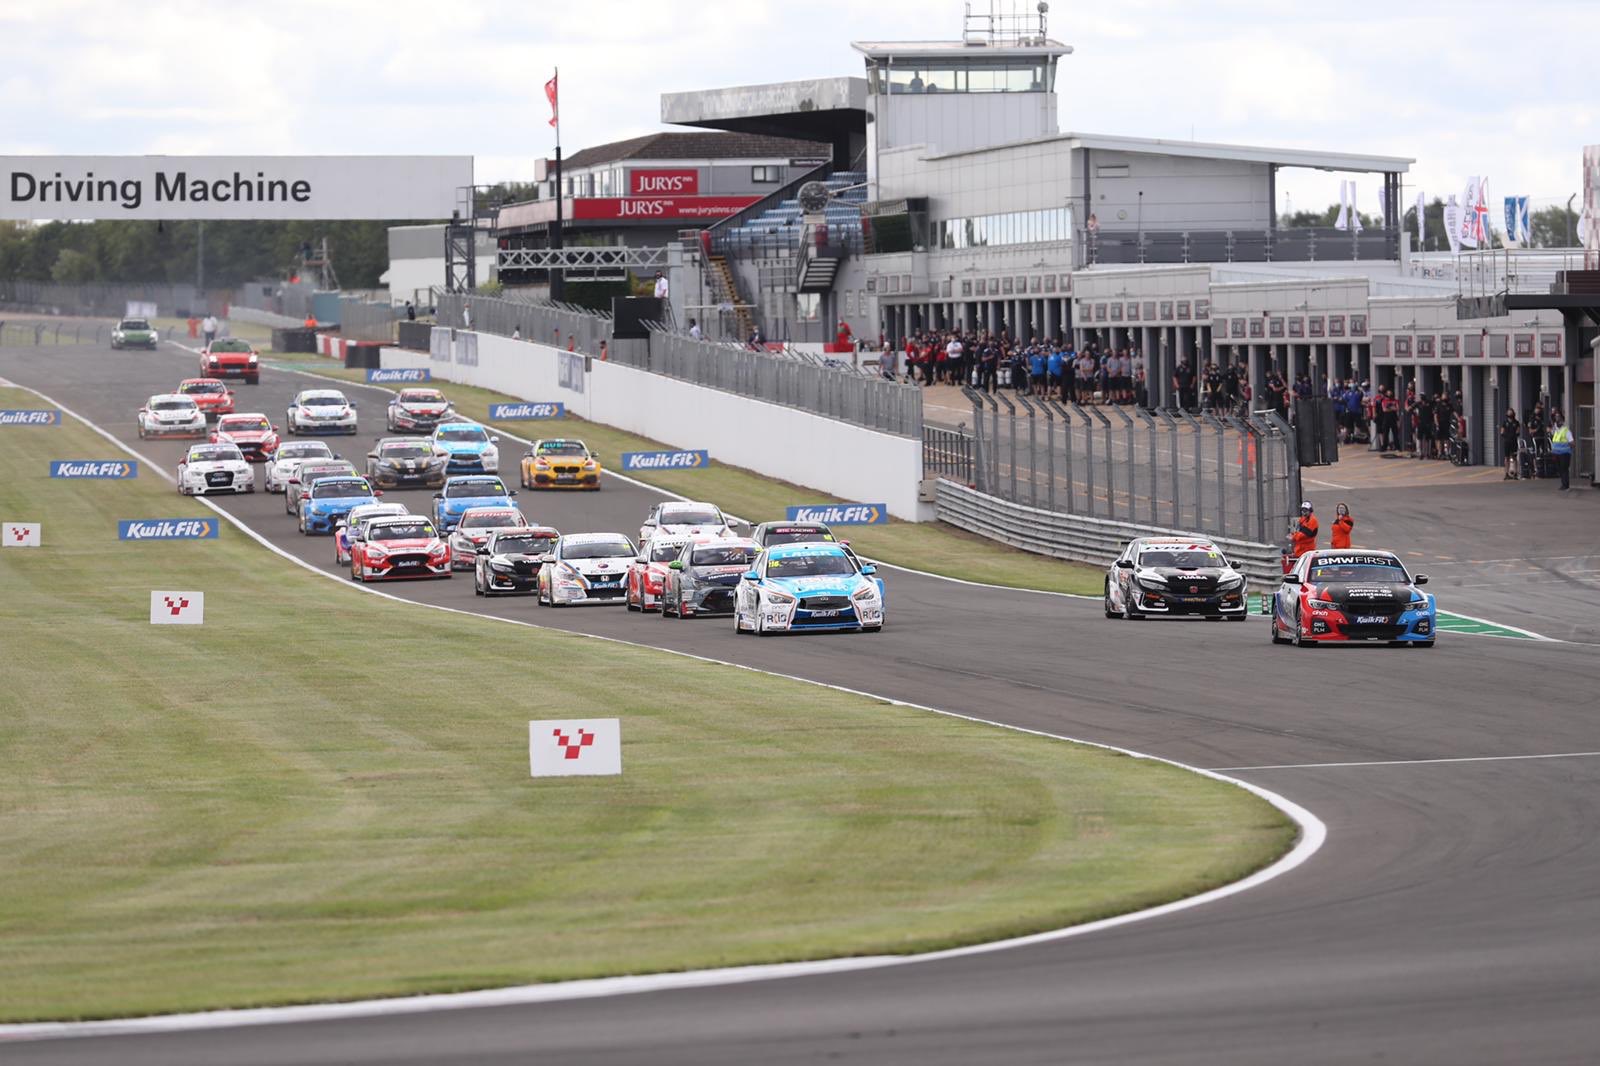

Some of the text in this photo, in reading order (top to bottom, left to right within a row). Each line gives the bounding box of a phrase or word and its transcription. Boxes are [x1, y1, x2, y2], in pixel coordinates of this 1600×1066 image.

[10, 171, 312, 209] Driving Machine
[636, 176, 683, 192] JURYS
[616, 200, 664, 216] JURYS
